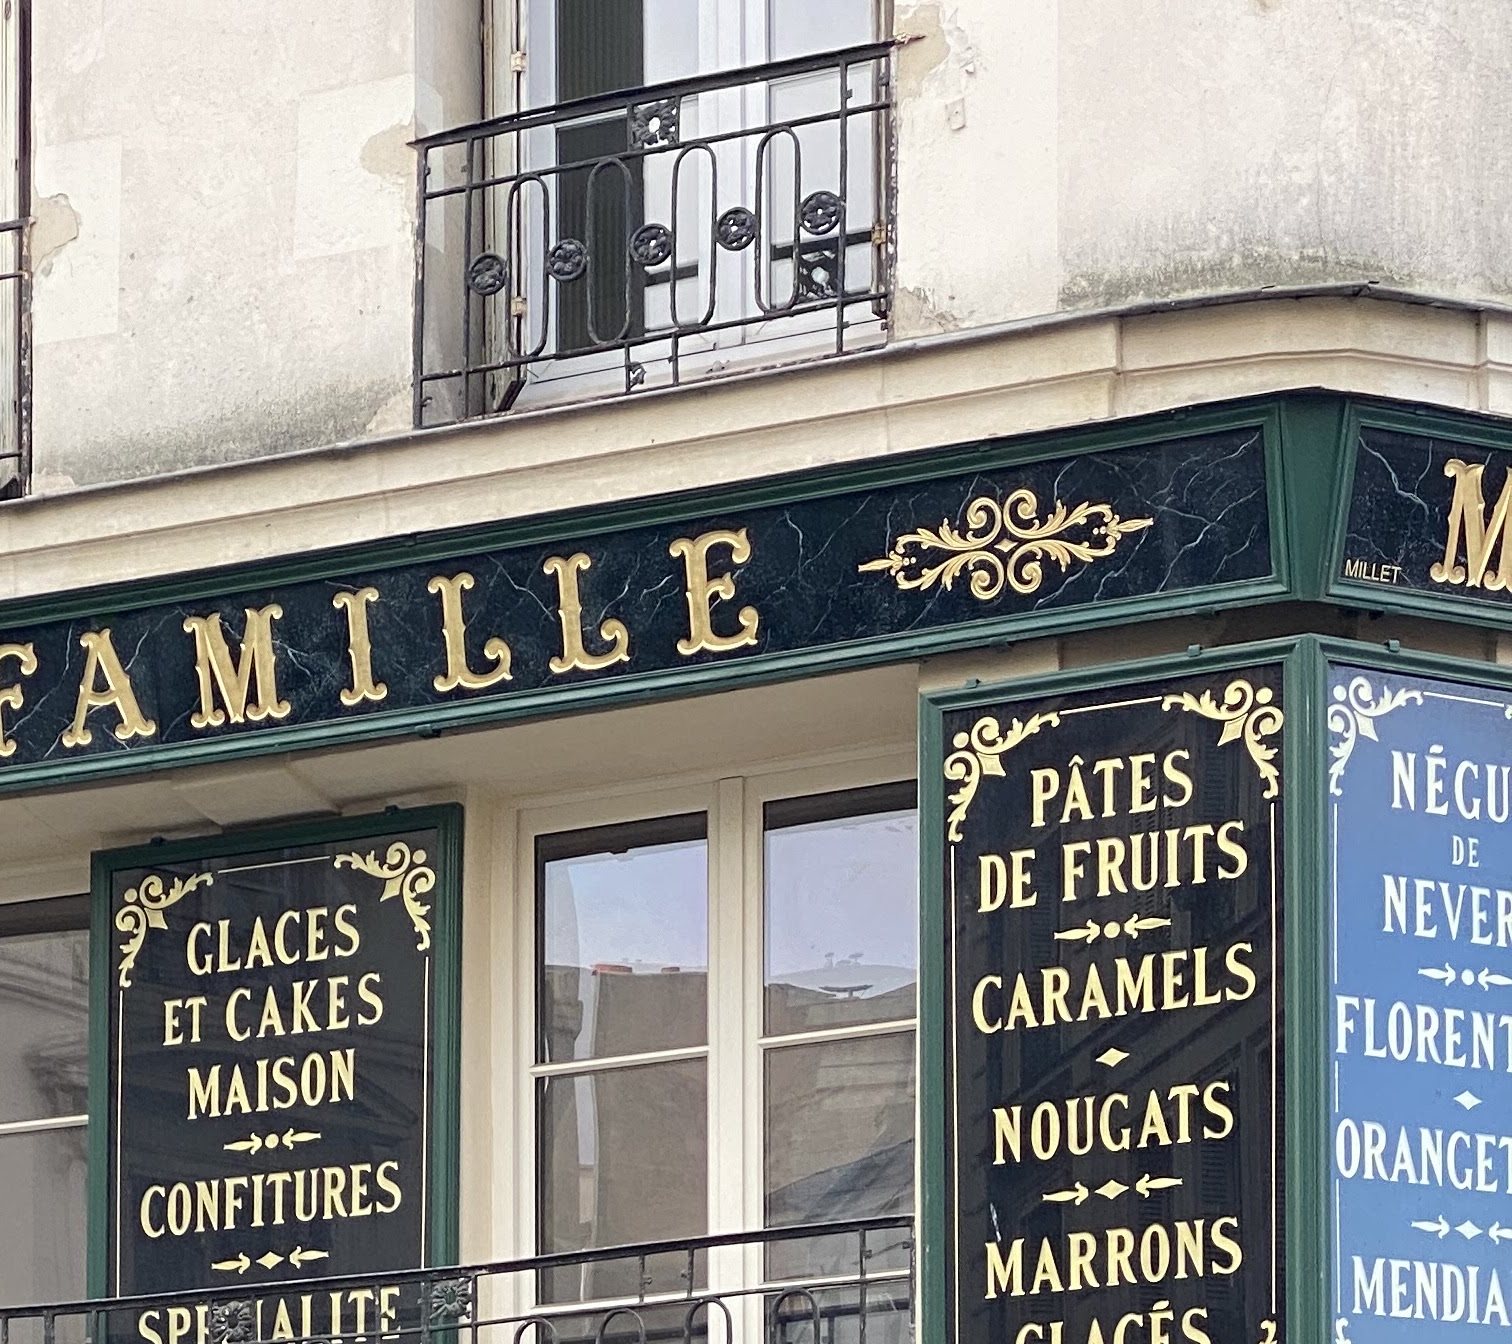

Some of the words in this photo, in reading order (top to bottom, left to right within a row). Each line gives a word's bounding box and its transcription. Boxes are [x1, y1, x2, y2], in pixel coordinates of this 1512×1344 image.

[1344, 558, 1402, 586] MILLET
[1030, 748, 1194, 828] PÂTES
[1390, 744, 1512, 823] NÉGU
[978, 848, 1038, 913] DE
[1062, 820, 1248, 902] FRUITS
[1451, 834, 1480, 868] DE
[187, 903, 360, 976] GLACES
[162, 995, 208, 1047] ET
[225, 972, 384, 1042] CAKES
[972, 942, 1257, 1034] CARAMELS
[186, 1047, 356, 1121] MAISON
[992, 1081, 1235, 1166] NOUGATS
[140, 1160, 403, 1238] CONFITURES
[984, 1216, 1243, 1300] MARRONS
[1351, 1255, 1512, 1327] MENDIA
